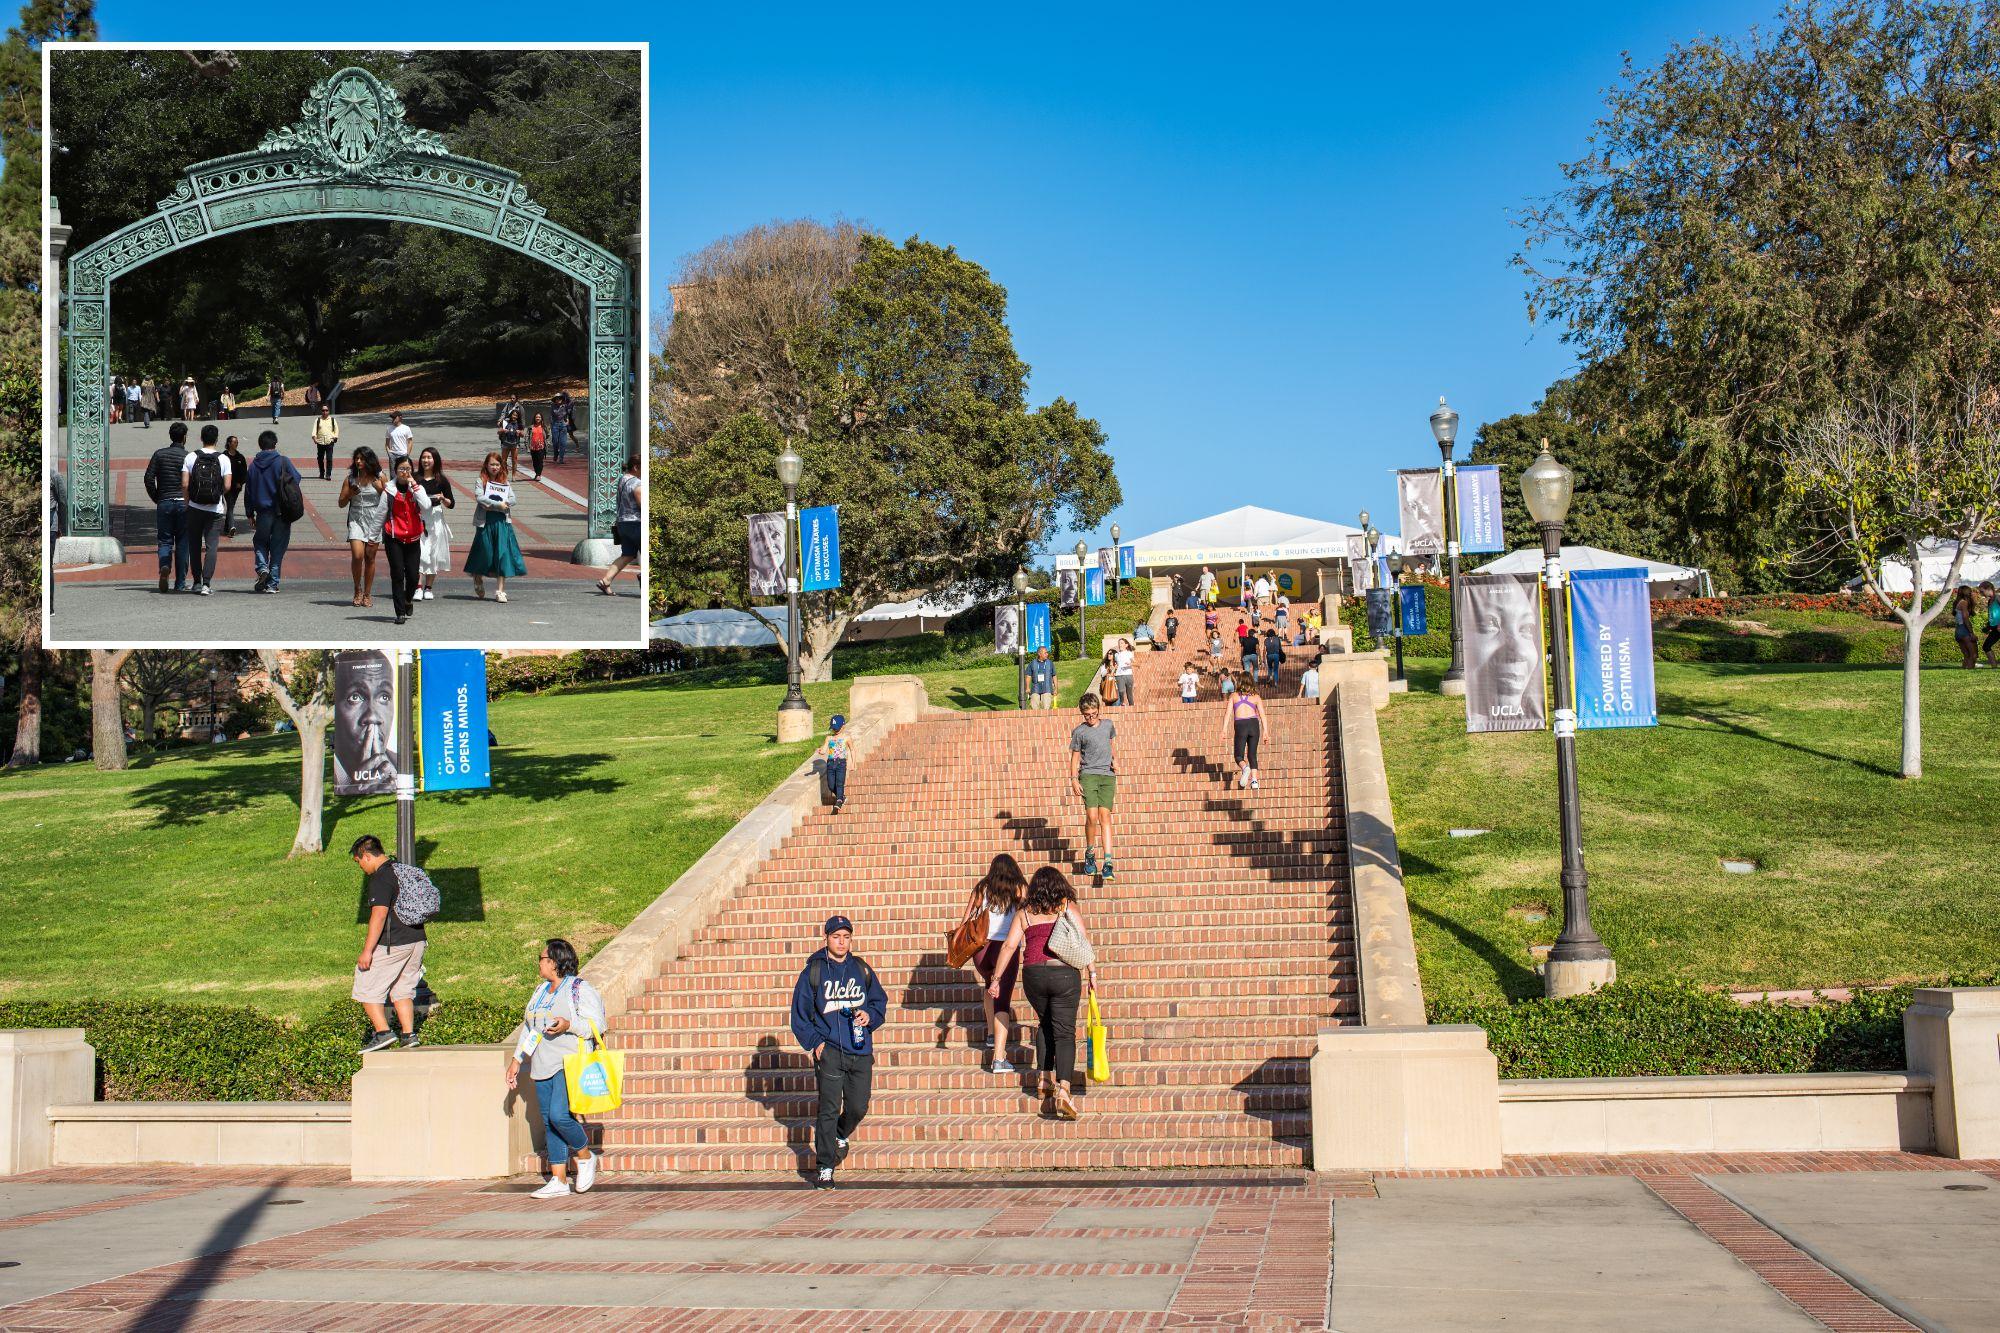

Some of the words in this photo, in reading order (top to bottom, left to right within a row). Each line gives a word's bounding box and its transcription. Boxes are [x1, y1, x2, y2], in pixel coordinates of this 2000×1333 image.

[262, 188, 363, 213] SATHER
[380, 191, 445, 215] GATE
[822, 534, 830, 567] EXCUSES.
[824, 568, 831, 581] NO
[1599, 624, 1611, 641] BY
[1601, 644, 1615, 712] POWERED
[1618, 637, 1633, 711] OPTIMISM.
[457, 683, 469, 729] MINDS.
[1491, 705, 1525, 717] UCLA
[443, 710, 455, 775] OPTIMISM
[458, 731, 471, 774] OPENS
[354, 770, 382, 781] UCLA
